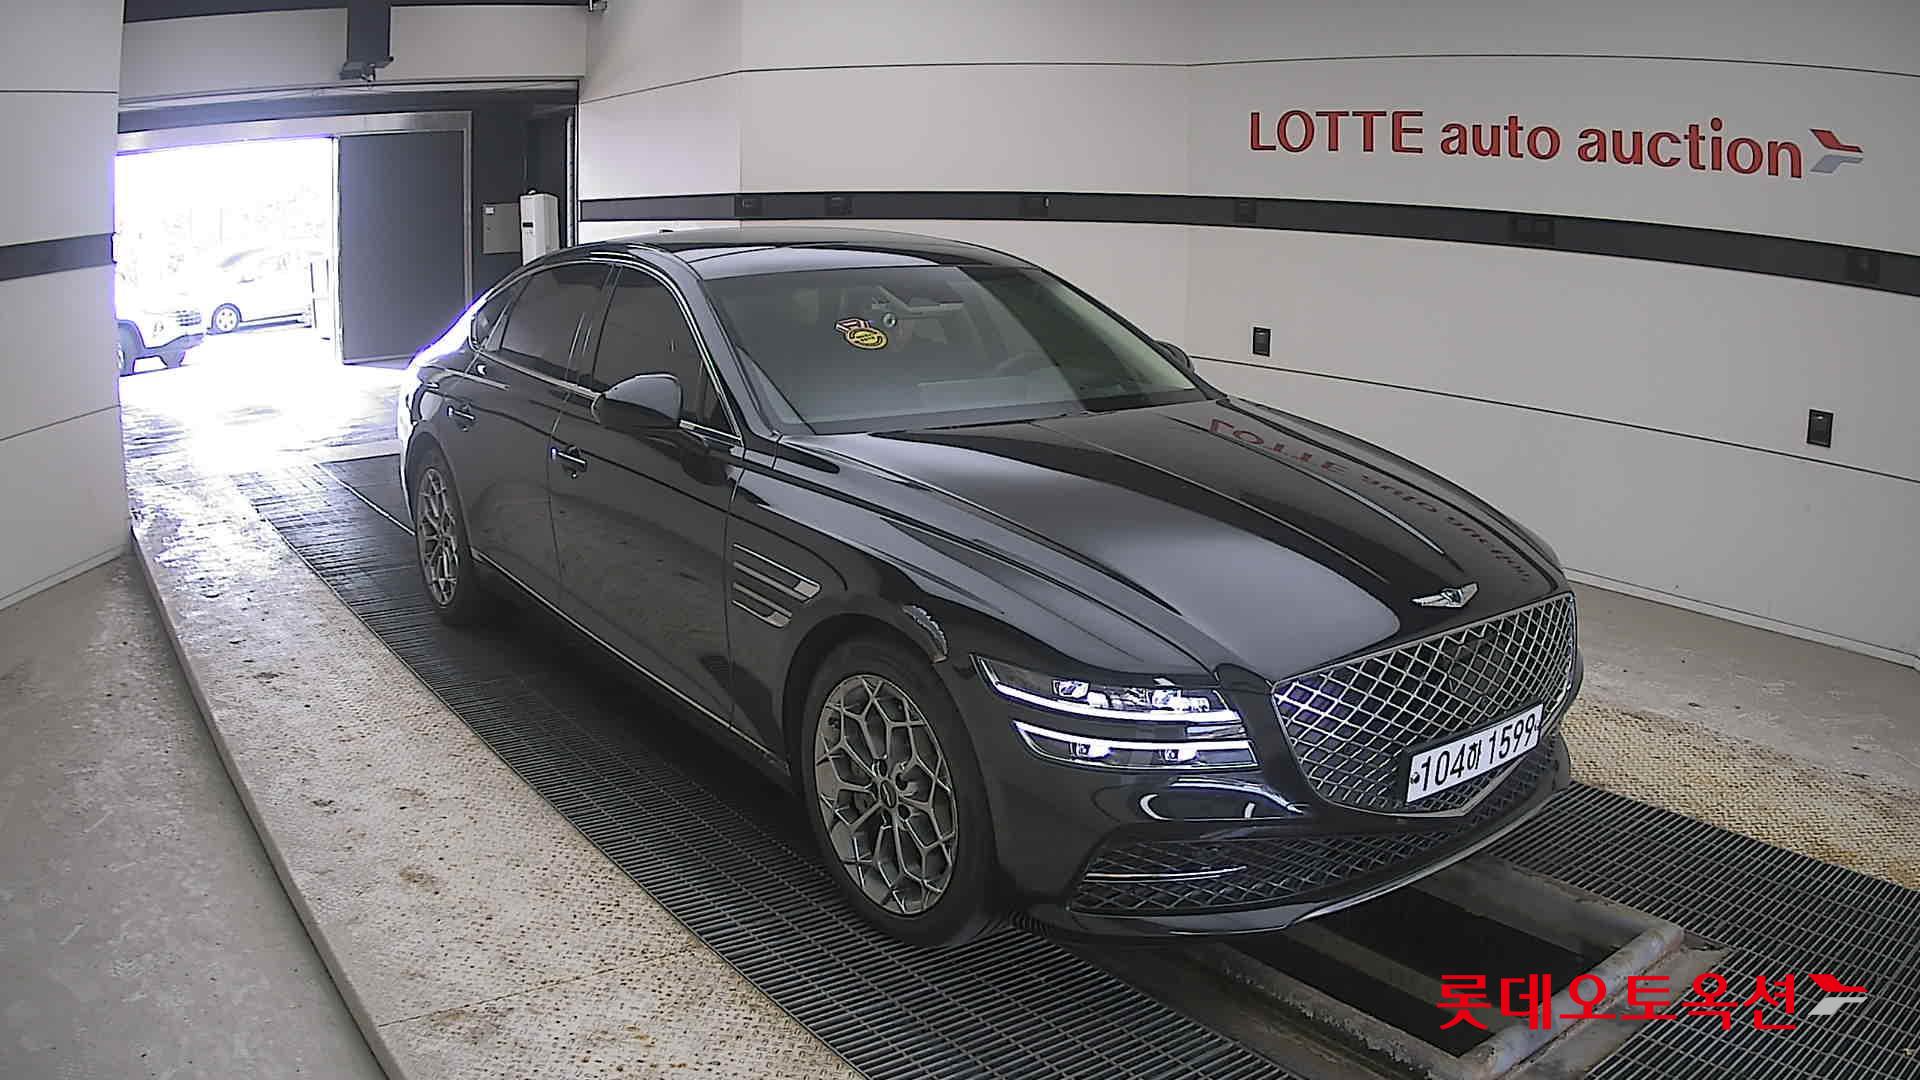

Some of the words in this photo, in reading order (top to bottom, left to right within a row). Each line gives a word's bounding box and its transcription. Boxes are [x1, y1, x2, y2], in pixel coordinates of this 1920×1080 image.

[1249, 110, 1424, 154] LOTTE
[1440, 115, 1561, 160] auto
[1577, 117, 1803, 179] auction
[1421, 739, 1483, 792] 104하
[1488, 713, 1536, 765] 1599
